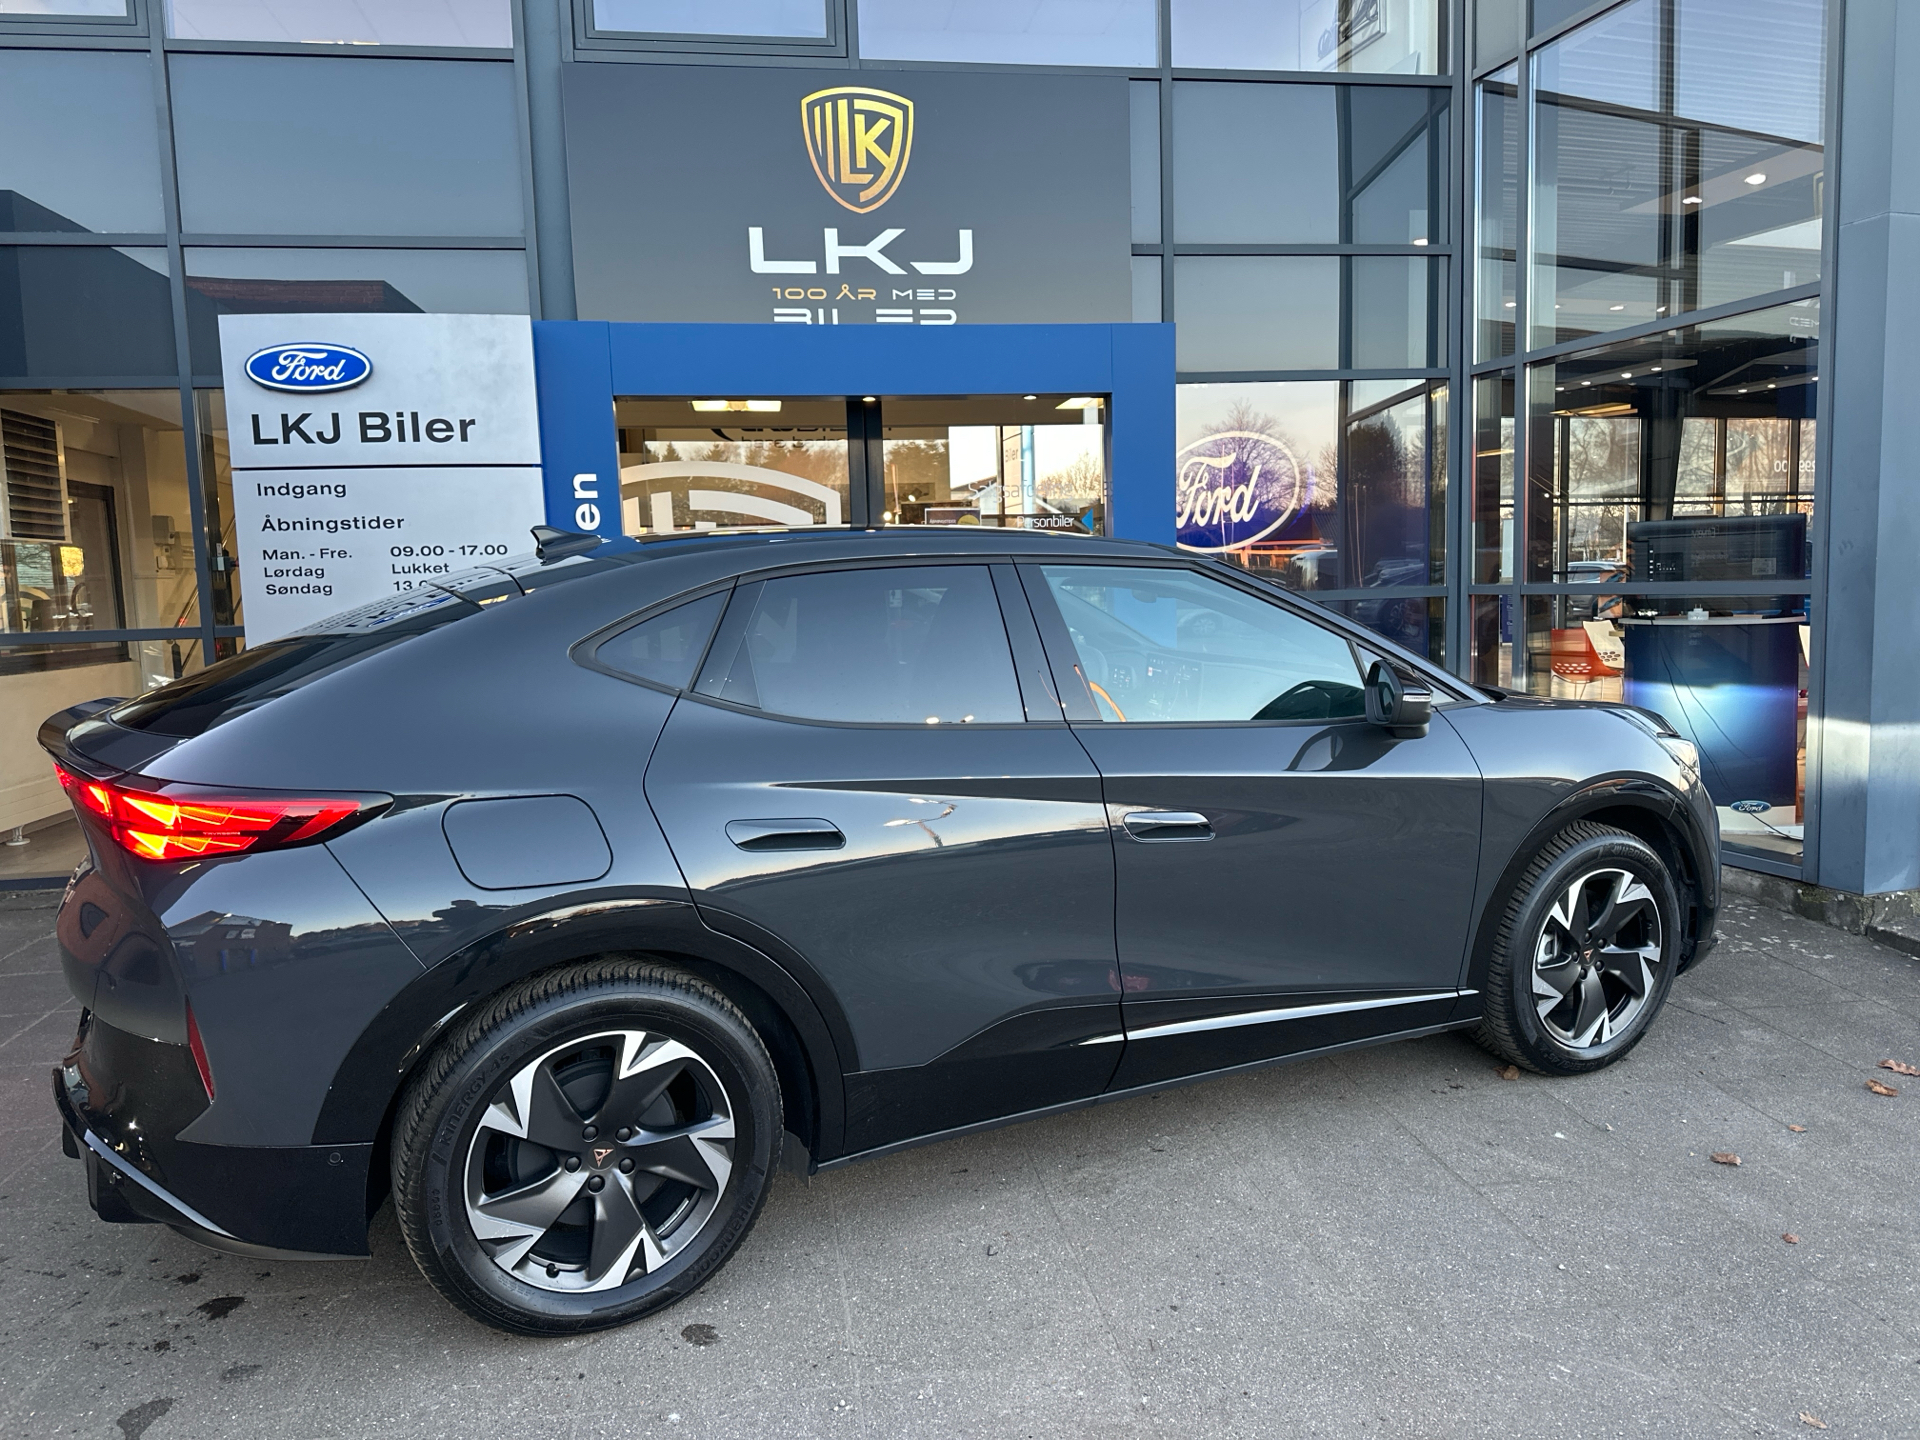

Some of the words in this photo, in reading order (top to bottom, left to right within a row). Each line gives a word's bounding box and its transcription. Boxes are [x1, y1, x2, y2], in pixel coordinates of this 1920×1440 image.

[748, 226, 974, 275] LKJ
[772, 287, 828, 300] 100
[835, 283, 877, 301] ÅR
[892, 288, 957, 301] MED
[271, 350, 346, 382] Ford
[251, 412, 342, 445] LKJ
[358, 411, 477, 444] Biler
[256, 482, 347, 499] Indgang
[1177, 452, 1263, 529] Ford
[572, 472, 601, 533] en
[261, 513, 406, 534] Åbningstider
[262, 548, 307, 561] Man.
[319, 547, 353, 560] Fre.
[390, 544, 446, 558] 09.00
[458, 544, 509, 557] 17.00
[263, 565, 326, 579] Lørdag
[391, 562, 450, 575] Lukket
[265, 582, 334, 597] Søndag
[1738, 802, 1765, 813] Ford
